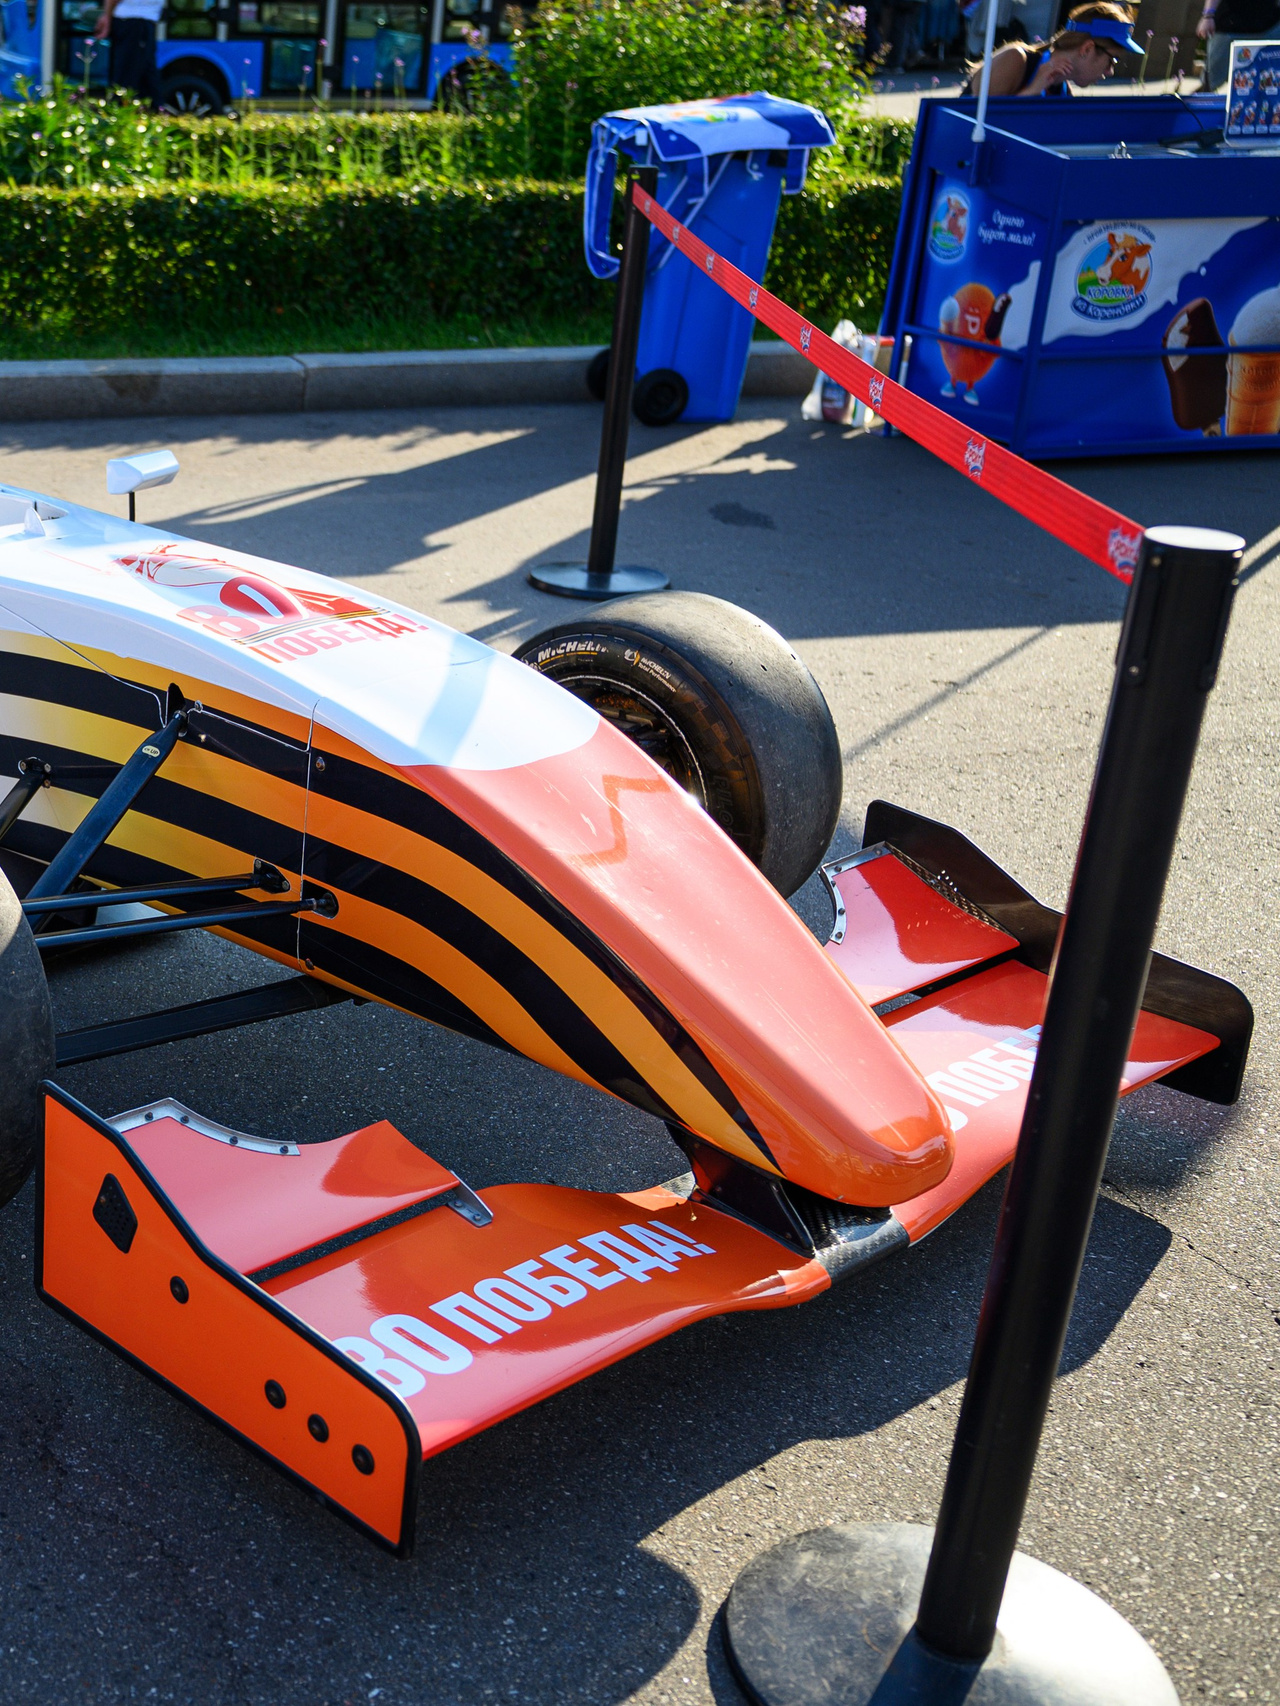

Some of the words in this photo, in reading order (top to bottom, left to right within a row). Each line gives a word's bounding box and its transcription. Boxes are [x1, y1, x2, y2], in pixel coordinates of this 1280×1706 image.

[176, 576, 310, 638] 80
[246, 613, 429, 664] ПОБЕДА!
[428, 1220, 718, 1344] ПОБЕДА!
